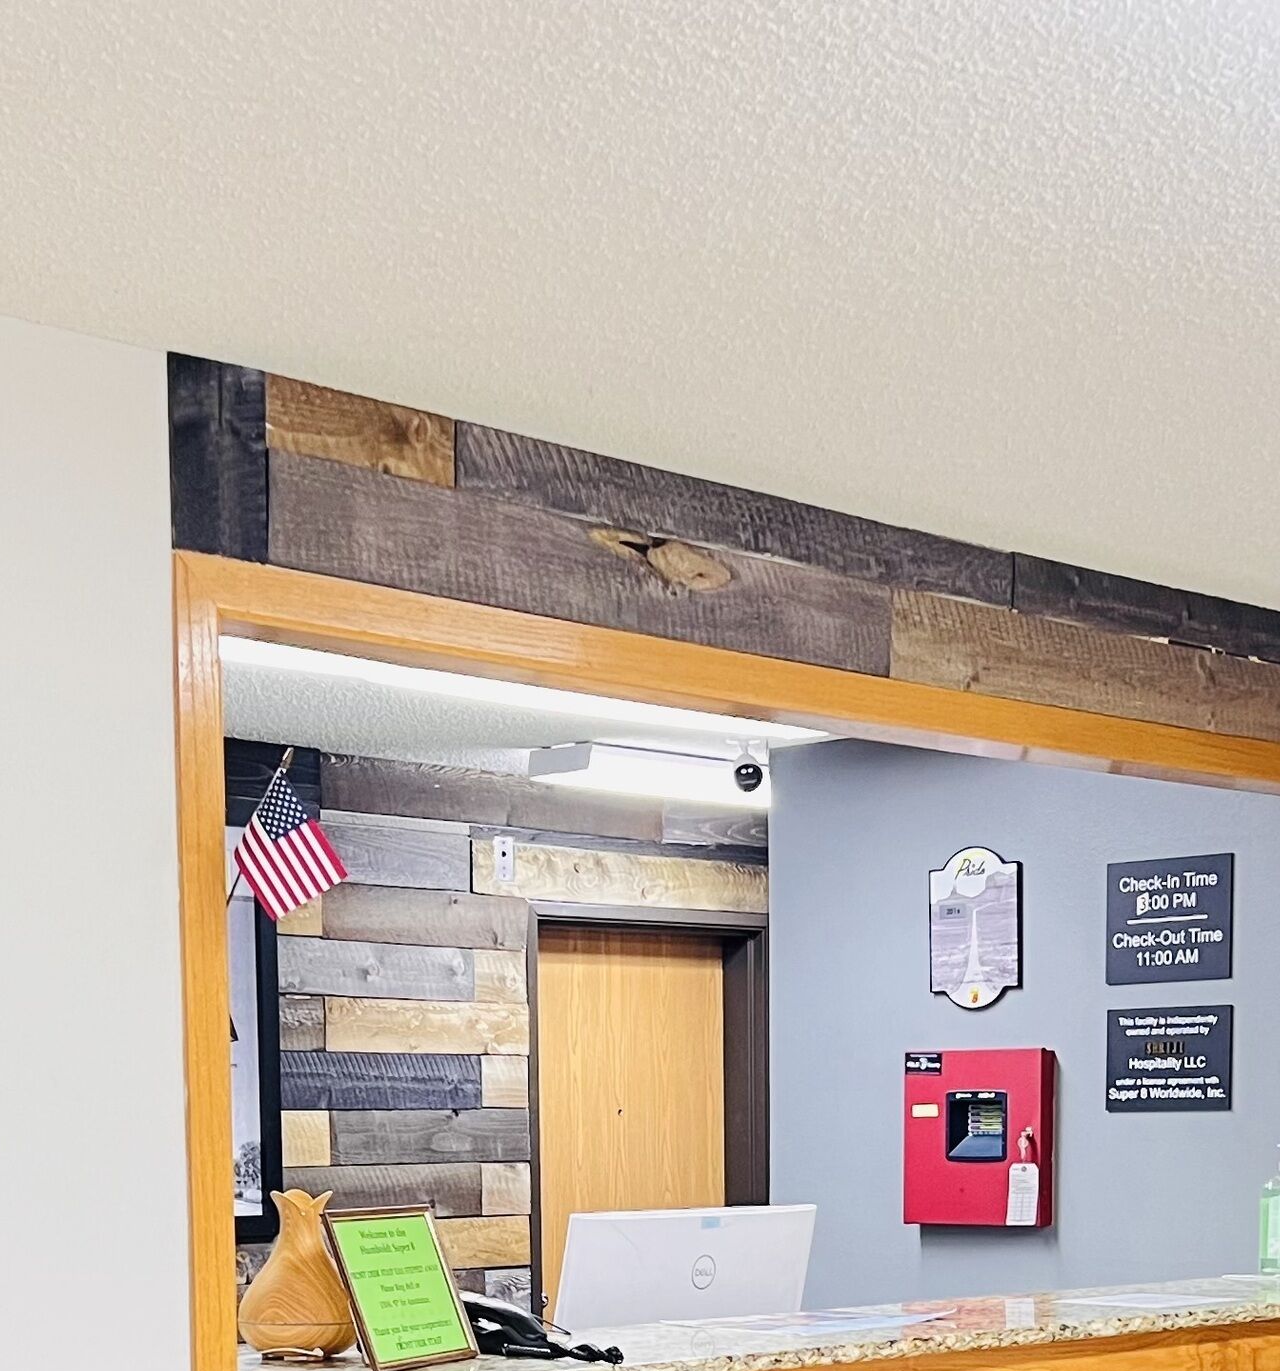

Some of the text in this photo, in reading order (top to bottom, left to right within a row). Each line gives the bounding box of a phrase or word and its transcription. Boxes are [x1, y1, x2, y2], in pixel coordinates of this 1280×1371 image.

[1119, 871, 1218, 893] Check-In Time
[1137, 892, 1197, 913] 3:00 PM
[1112, 927, 1223, 949] Check-Out Time
[1136, 948, 1199, 967] 11:00 AM
[1199, 1025, 1210, 1036] by
[1128, 1055, 1207, 1072] Hospitality LLC
[1108, 1085, 1226, 1102] Super 8 Worldwide, Inc.
